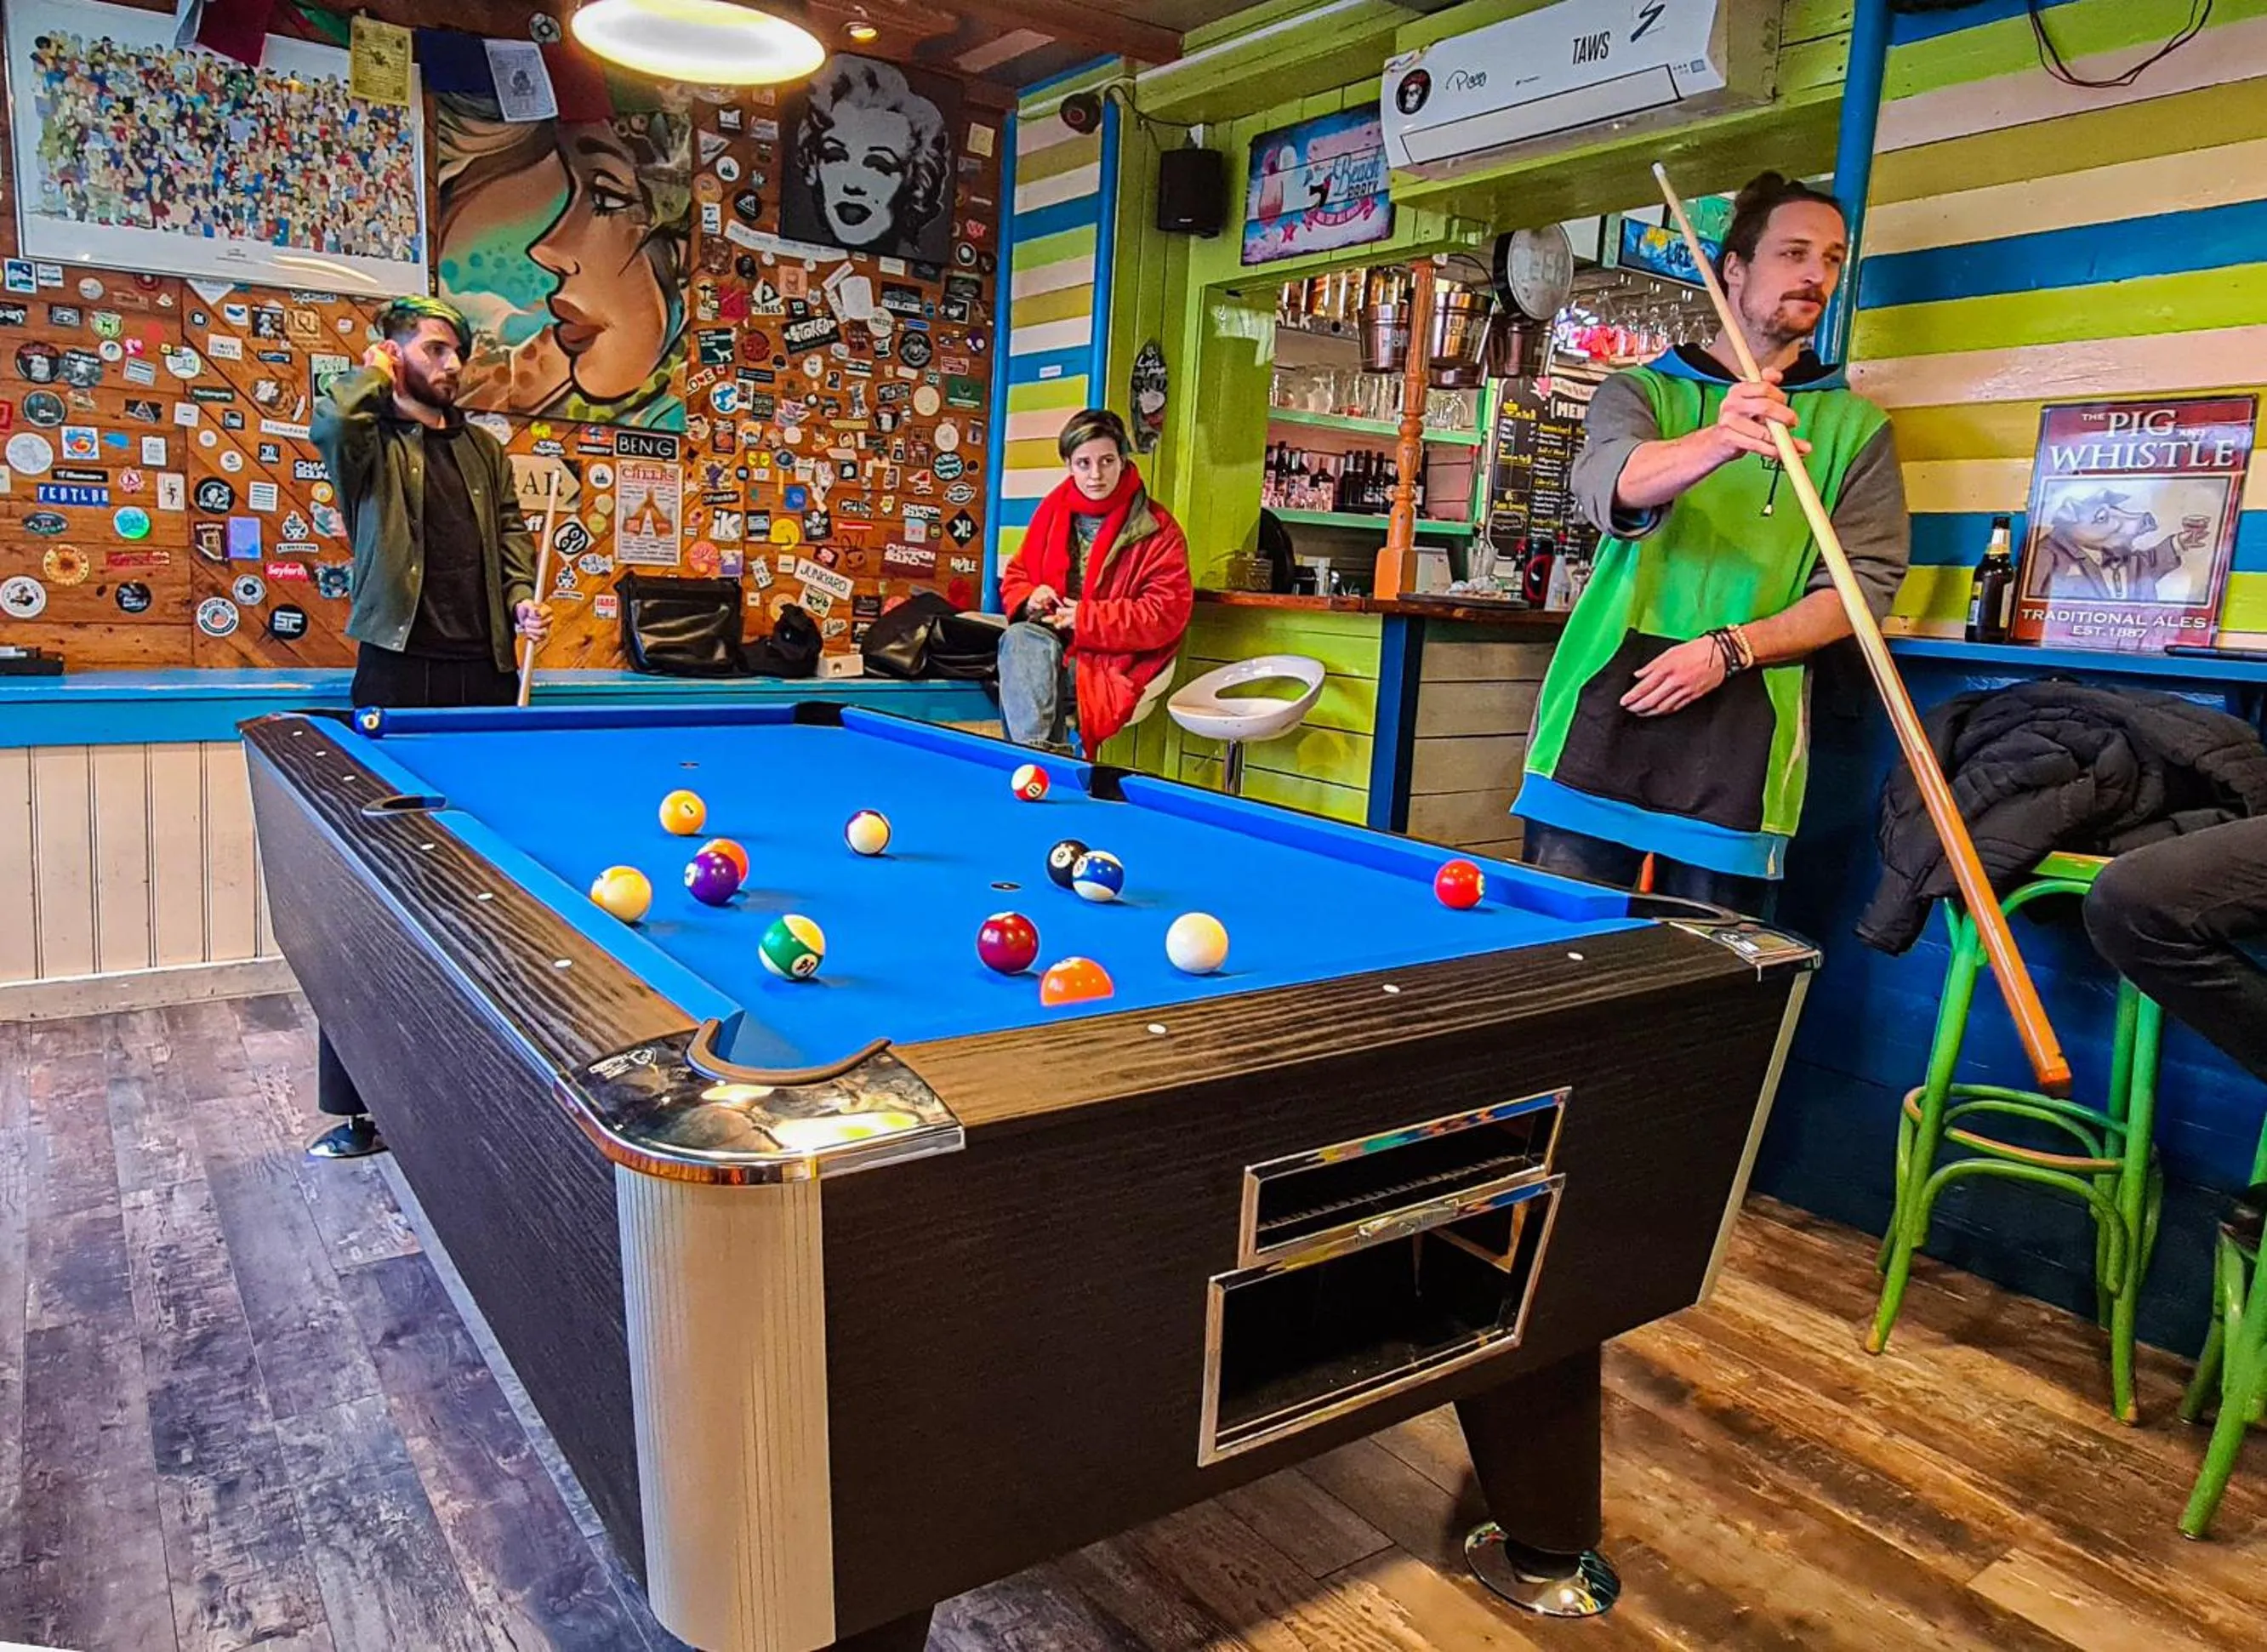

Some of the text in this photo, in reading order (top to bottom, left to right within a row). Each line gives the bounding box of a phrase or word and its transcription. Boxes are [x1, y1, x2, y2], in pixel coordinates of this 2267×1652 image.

[1573, 31, 1610, 65] TAWS
[2082, 409, 2206, 439] THE PIG AND
[619, 436, 674, 456] BENG
[2049, 439, 2237, 471] WHISTLE
[2021, 608, 2207, 629] TRADITIONAL ALES
